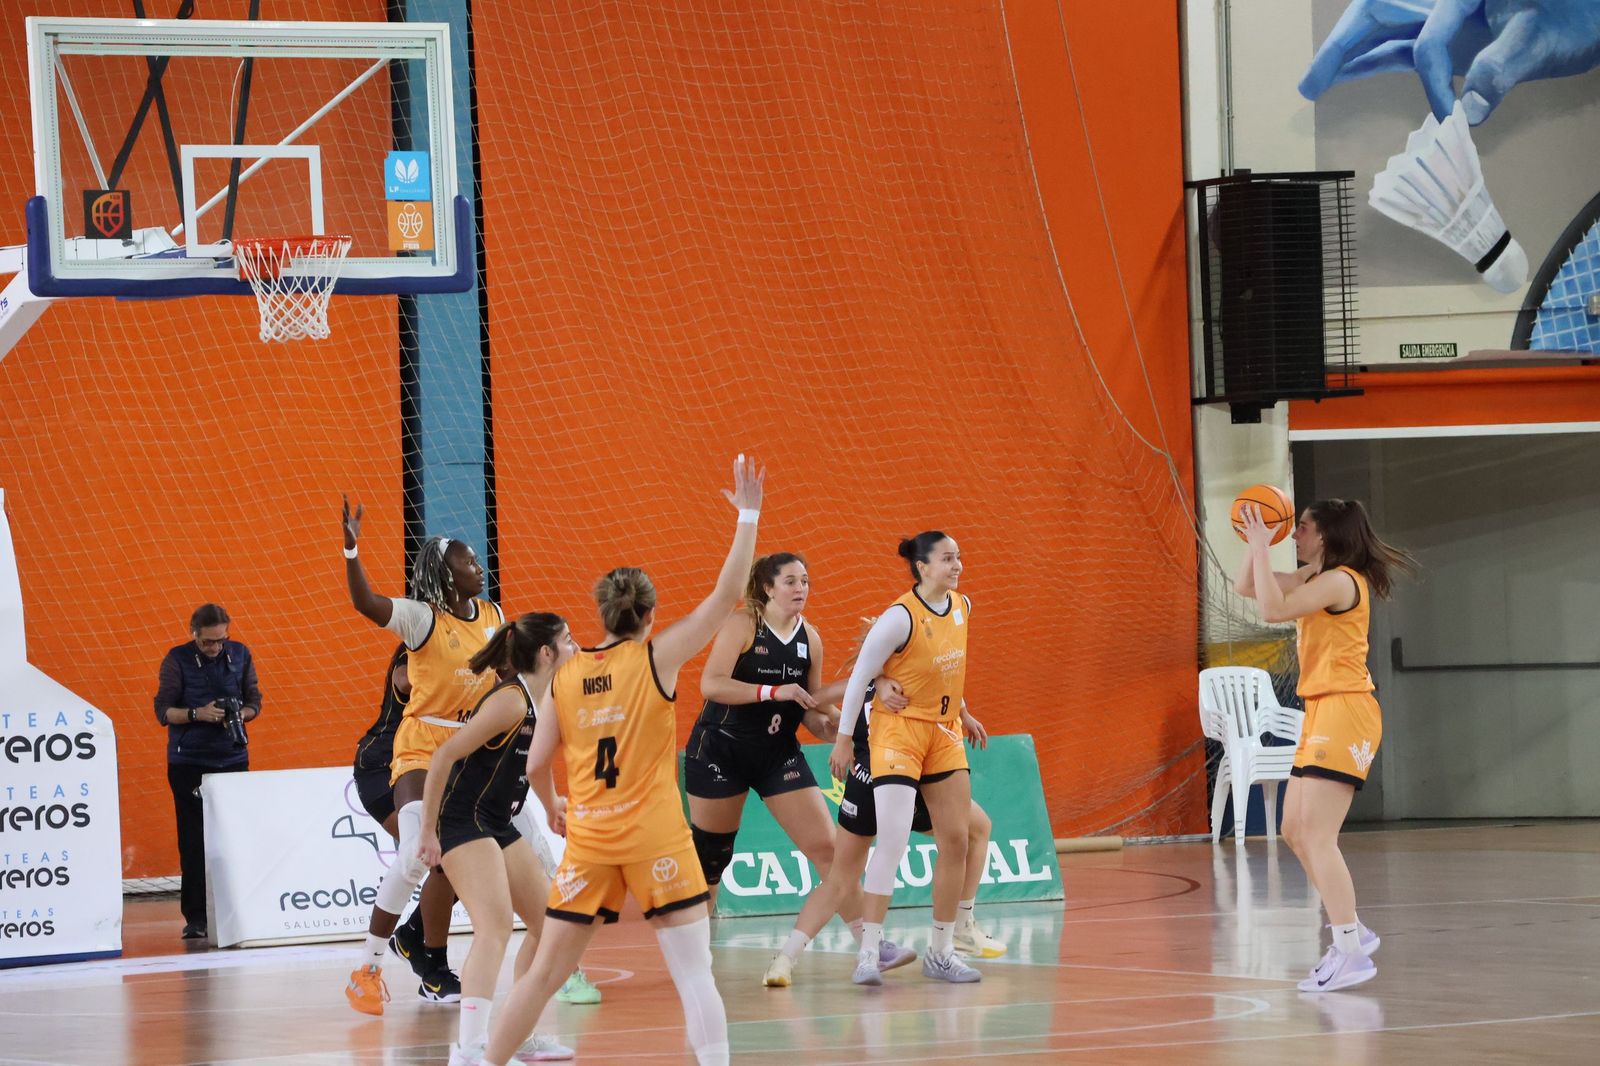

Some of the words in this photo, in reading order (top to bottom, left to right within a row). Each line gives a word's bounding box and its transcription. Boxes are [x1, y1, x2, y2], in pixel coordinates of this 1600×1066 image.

[1402, 345, 1421, 358] SALIDA
[1421, 344, 1456, 357] EMERGENCIA
[583, 674, 612, 695] NISKI
[940, 695, 950, 716] 8
[767, 713, 782, 735] 8
[594, 736, 620, 789] 4
[284, 916, 335, 931] SALUD
